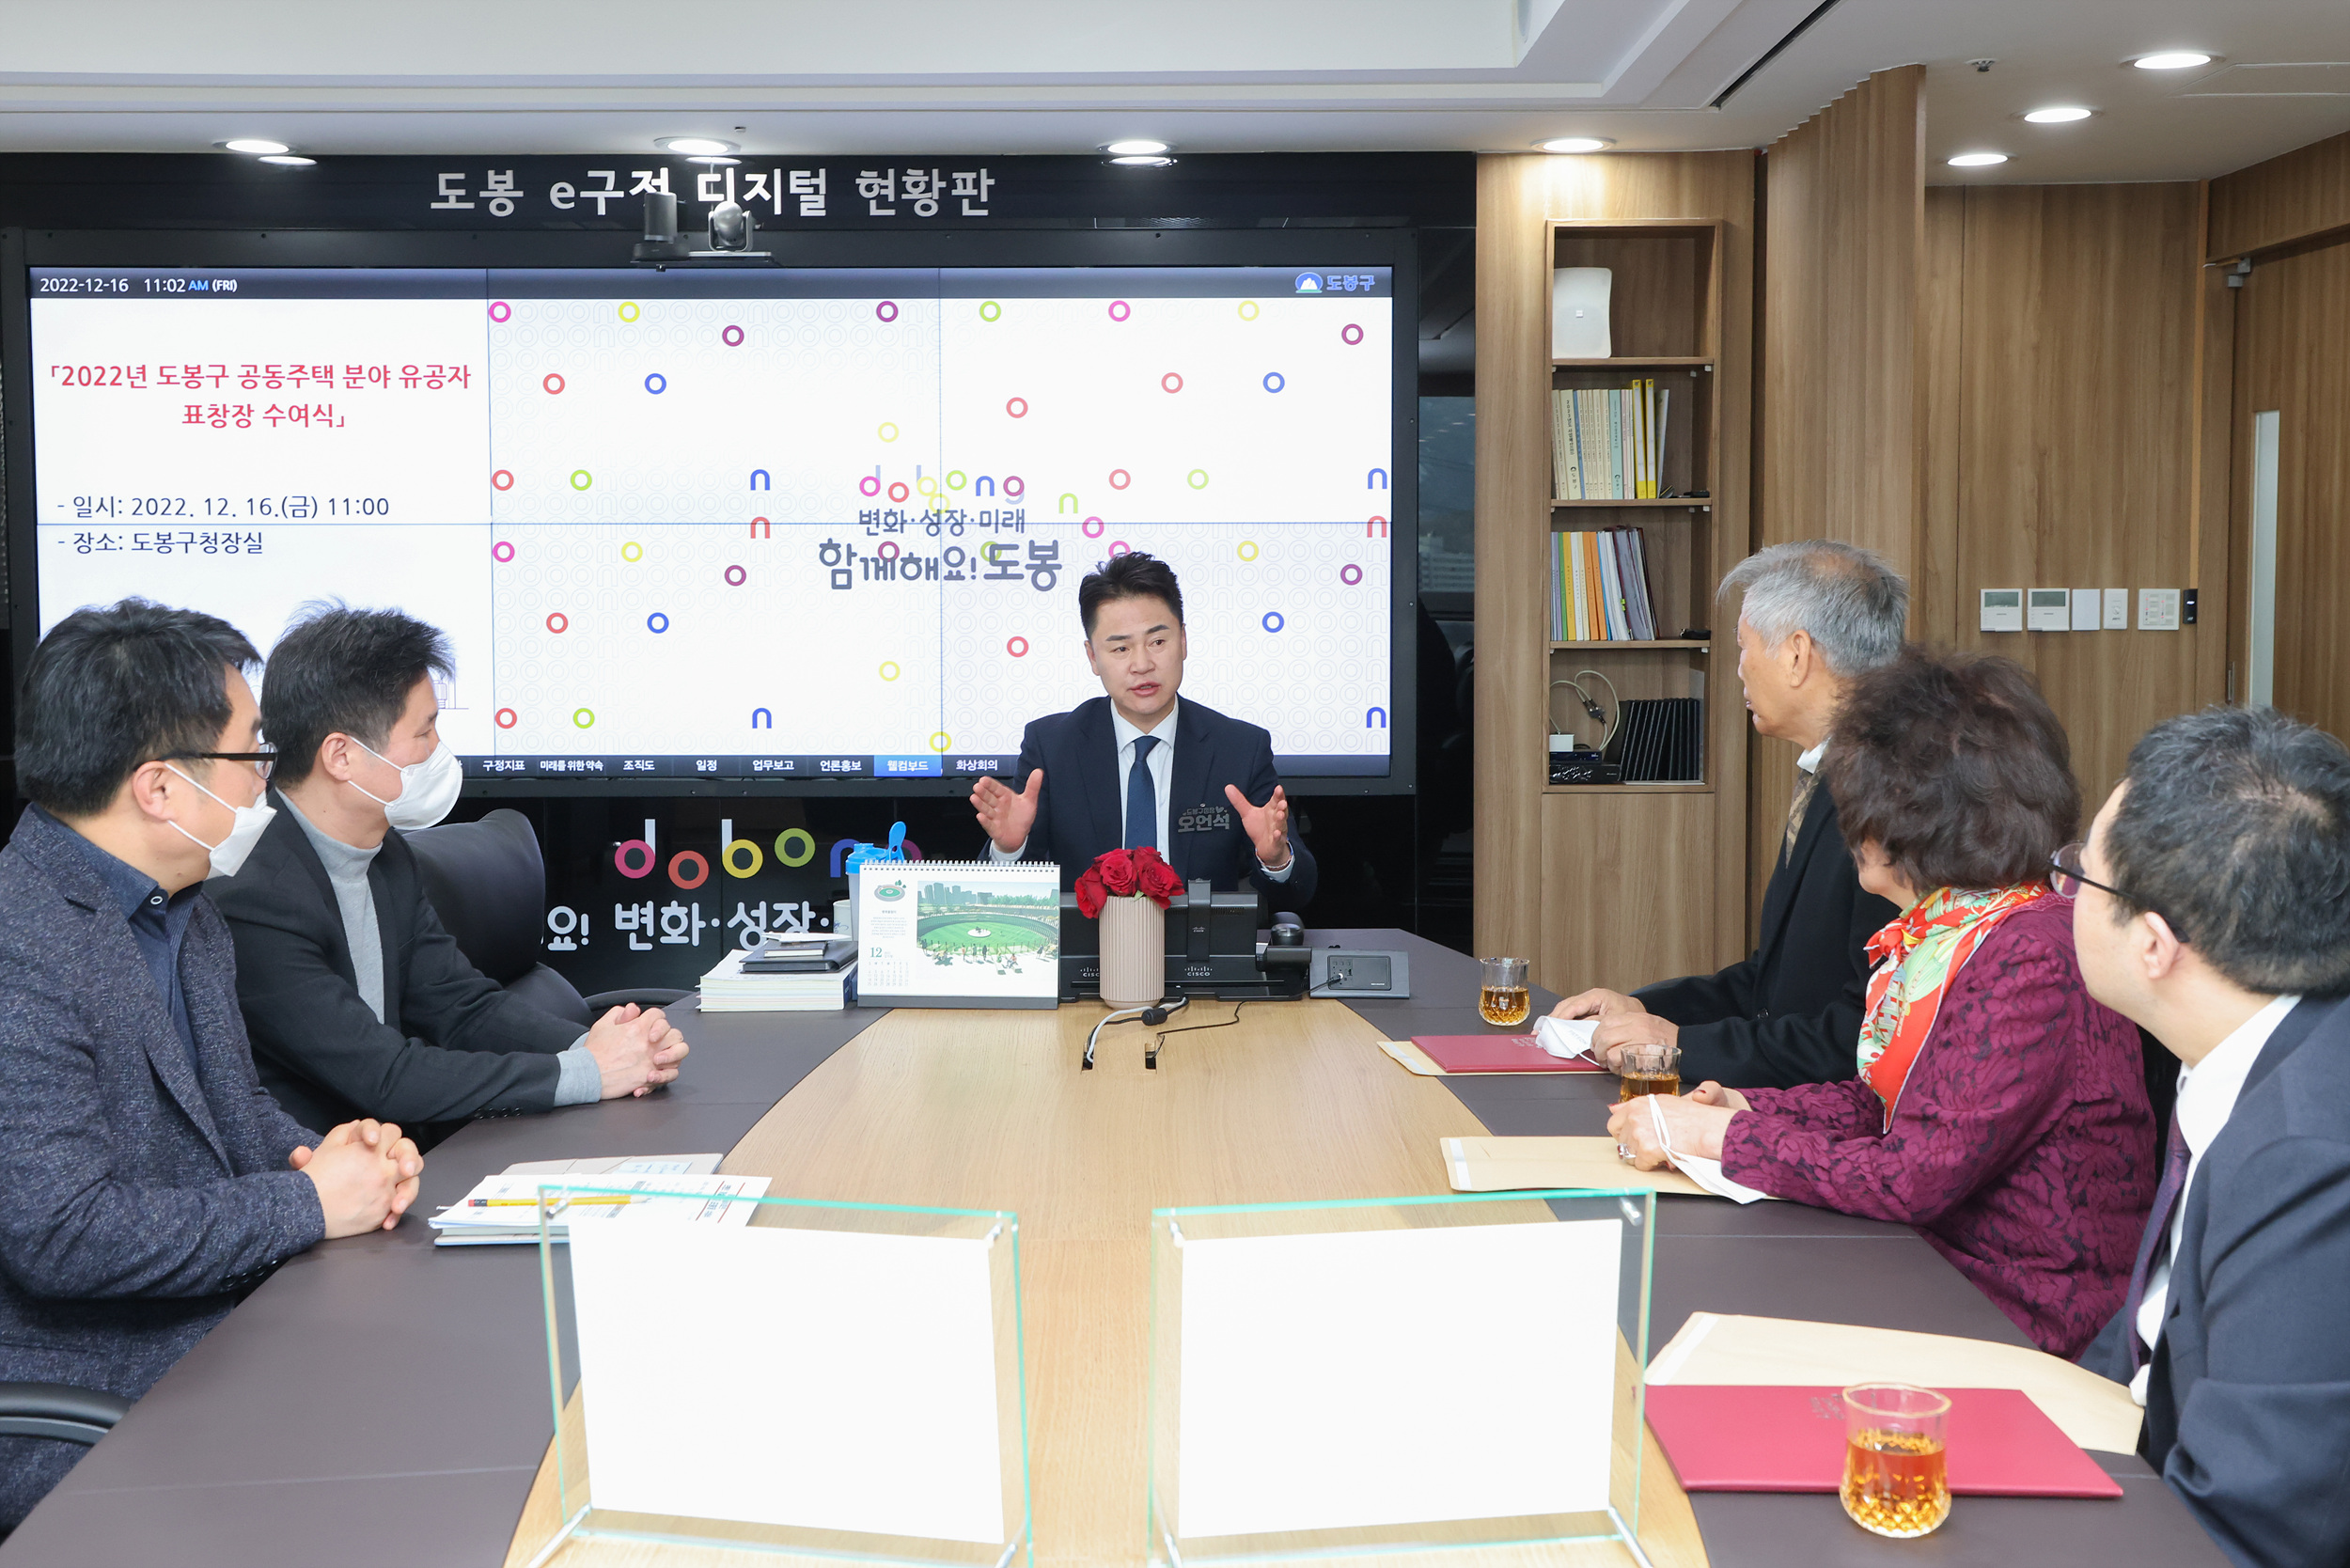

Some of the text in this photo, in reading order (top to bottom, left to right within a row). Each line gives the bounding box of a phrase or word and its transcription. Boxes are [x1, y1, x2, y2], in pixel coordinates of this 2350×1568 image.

[430, 169, 524, 217] 도봉
[697, 167, 827, 217] 디지털
[855, 168, 995, 217] 현황판
[39, 277, 238, 293] 2022-12-16 11:02 AM (FRI)
[1325, 274, 1376, 291] 도봉구
[157, 364, 229, 390] 도봉구
[237, 364, 334, 390] 공동주택
[342, 364, 391, 390] 분야
[399, 364, 472, 390] 유공자
[181, 403, 255, 429] 표창장
[72, 494, 123, 518] 일시:
[132, 497, 195, 518] 2022.
[204, 497, 238, 518] 12.
[328, 497, 389, 516] 11:00
[72, 531, 123, 555] 장소:
[131, 531, 263, 555] 도봉구청장실
[819, 537, 1062, 591] 함께해요! 도봉
[482, 759, 525, 772] 구정지표
[540, 760, 604, 772] 미래를 위한 약속
[622, 759, 656, 772] 조직도
[696, 759, 717, 772] 일정
[752, 759, 795, 772] 업무보고
[820, 759, 862, 773] 언론홍보
[955, 759, 998, 772] 화상회의
[1178, 813, 1230, 833] 오언석
[541, 905, 589, 951] 요!
[870, 947, 883, 958] 12
